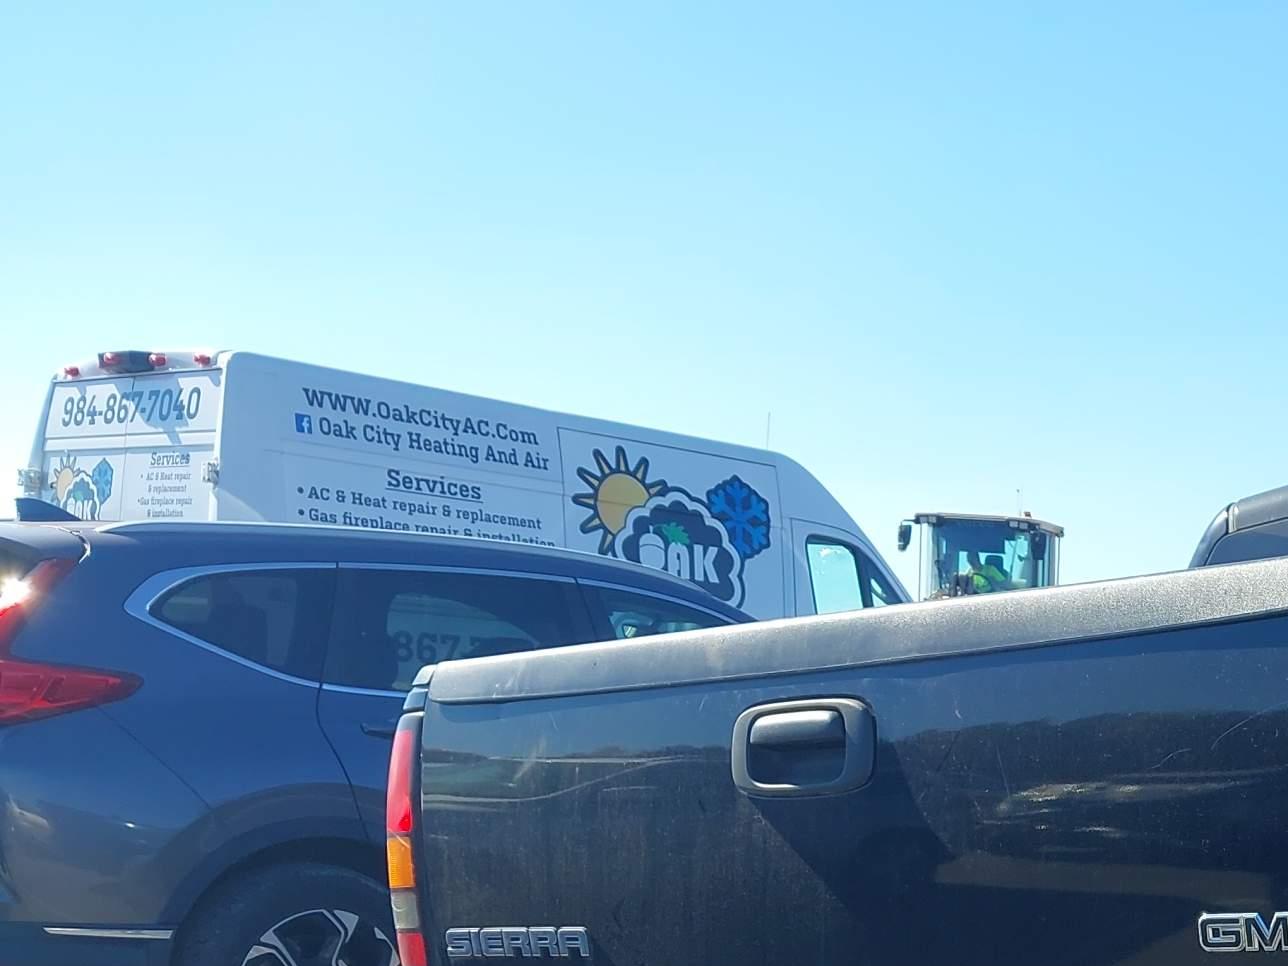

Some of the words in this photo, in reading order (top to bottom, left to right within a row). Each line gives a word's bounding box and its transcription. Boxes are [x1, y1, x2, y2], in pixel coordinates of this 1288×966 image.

[62, 386, 201, 427] 984-867-7040
[302, 387, 539, 445] WWW.OakCityAC.Com
[150, 451, 190, 466] Services
[319, 416, 357, 440] Oak
[363, 424, 401, 451] City
[407, 431, 479, 464] Heating
[485, 445, 519, 466] And
[524, 451, 549, 470] Air
[386, 468, 481, 500] Services
[308, 486, 330, 501] AC
[336, 490, 346, 503] &
[351, 491, 387, 509] Heat
[393, 500, 437, 516] repair
[442, 504, 451, 517] &
[456, 508, 542, 529] replacement
[308, 508, 337, 524] Gas
[342, 511, 410, 532] fireplace
[445, 926, 590, 957] SIERRA
